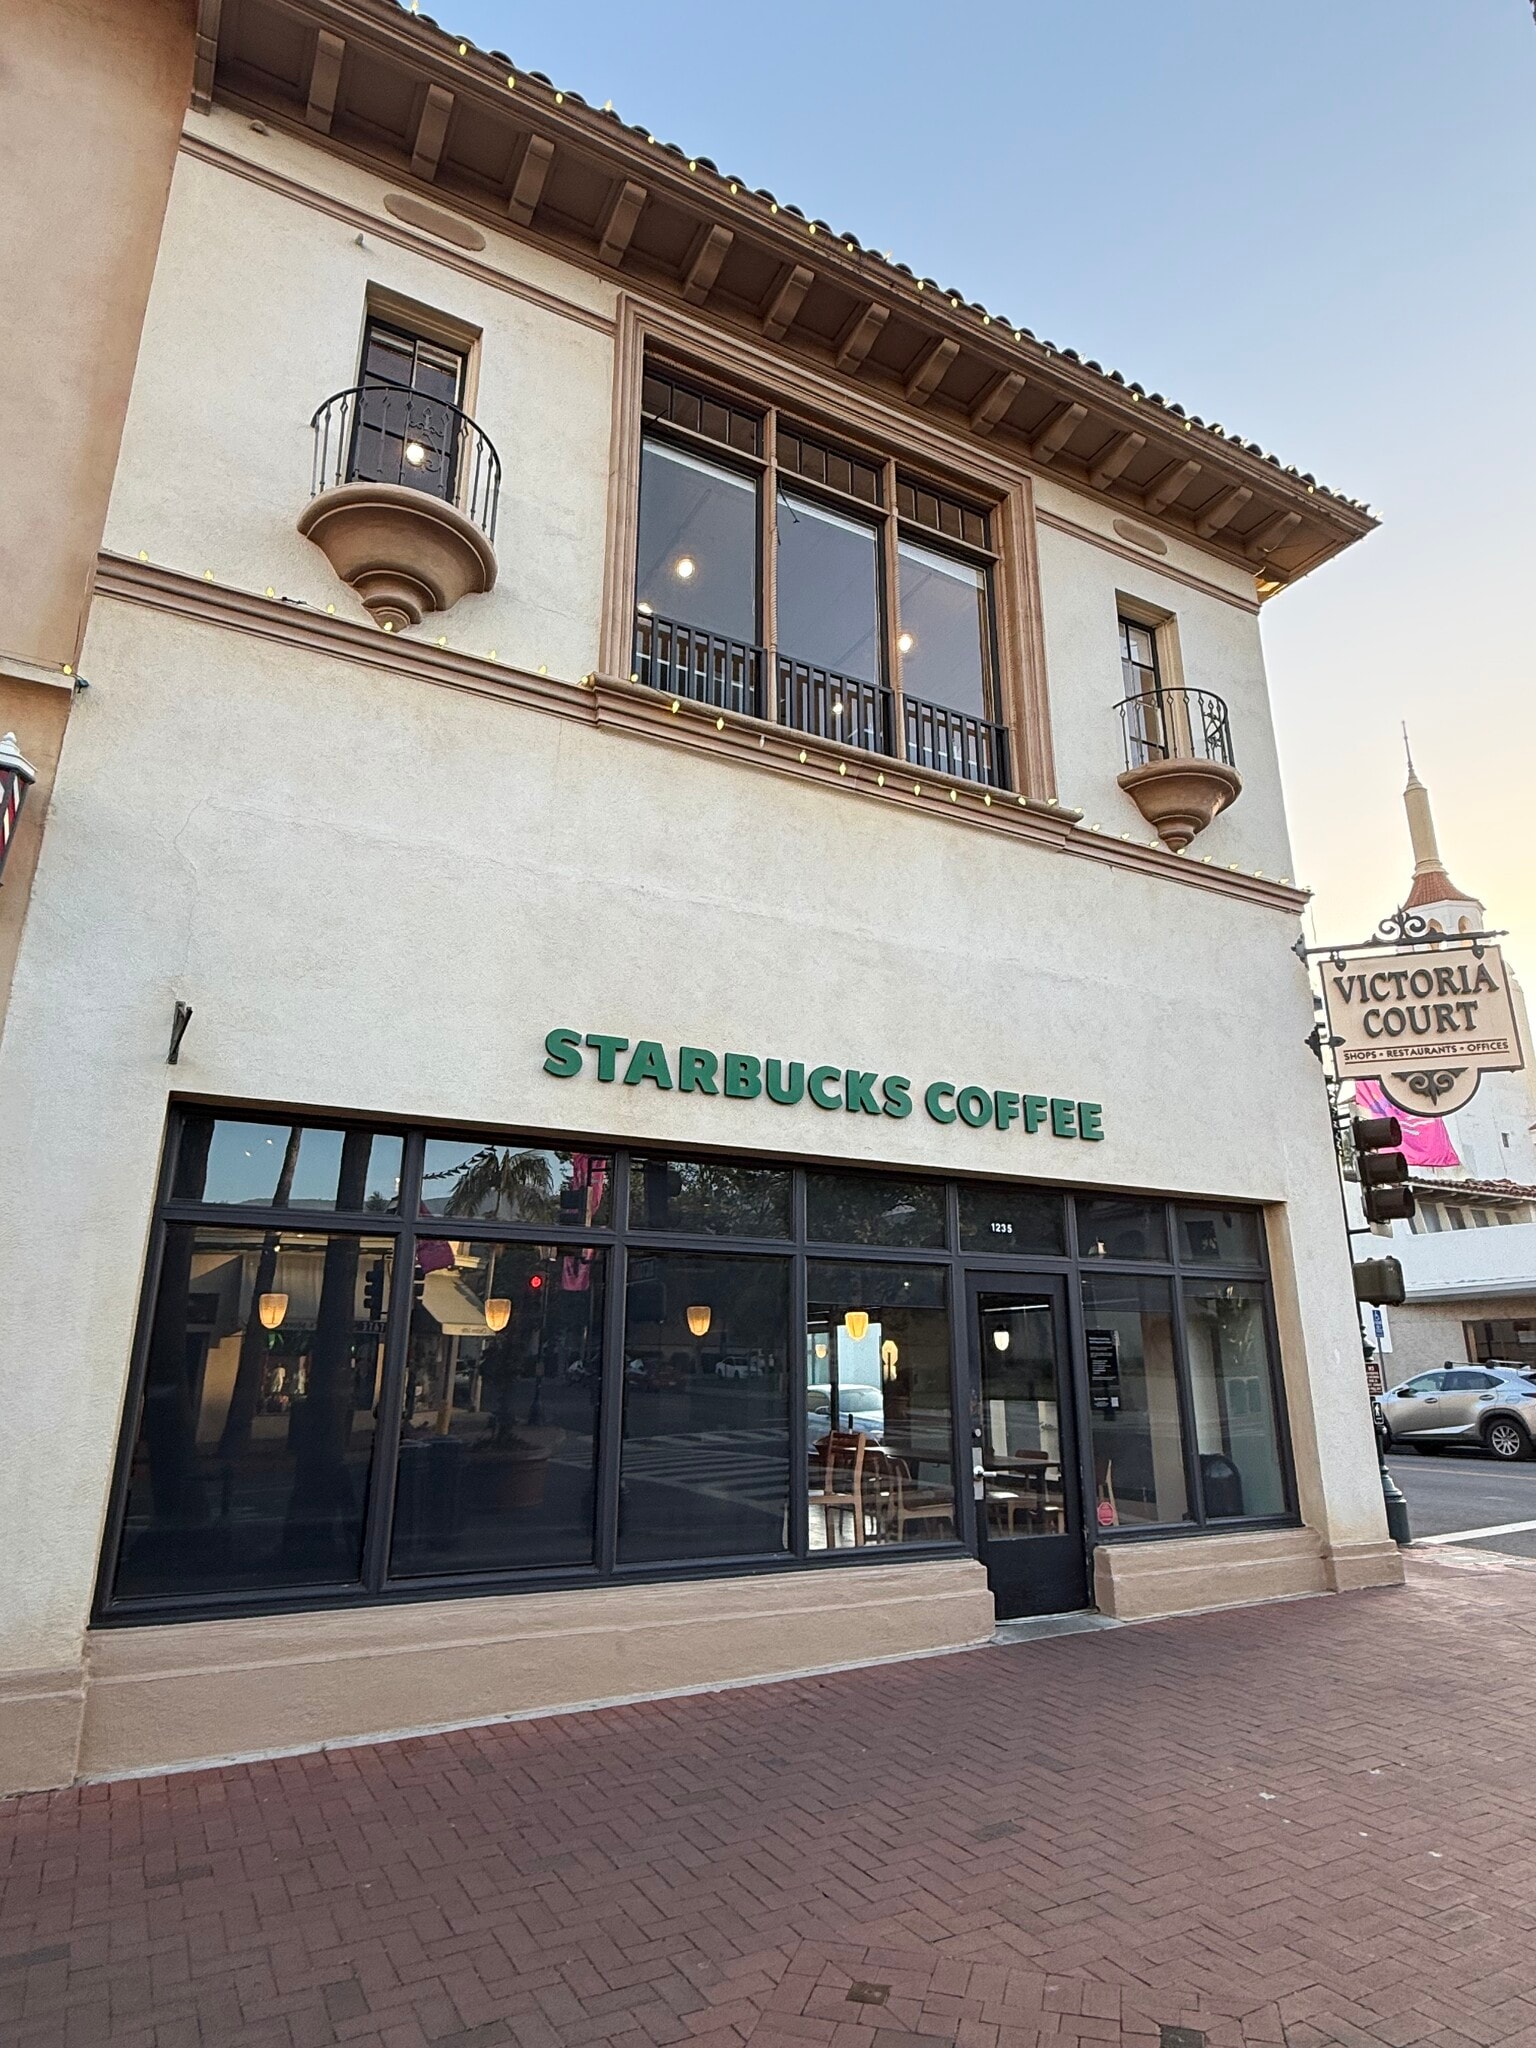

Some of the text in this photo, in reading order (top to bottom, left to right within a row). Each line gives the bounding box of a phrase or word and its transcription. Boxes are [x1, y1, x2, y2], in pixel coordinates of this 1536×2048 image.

[1333, 963, 1499, 1004] VICTORIA
[1363, 1001, 1478, 1038] COURT
[1344, 1041, 1509, 1061] SHOPS RESTAURANTS OFFICES
[543, 1028, 1105, 1141] STARBUCKS COFFEE
[990, 1222, 1013, 1234] 1235
